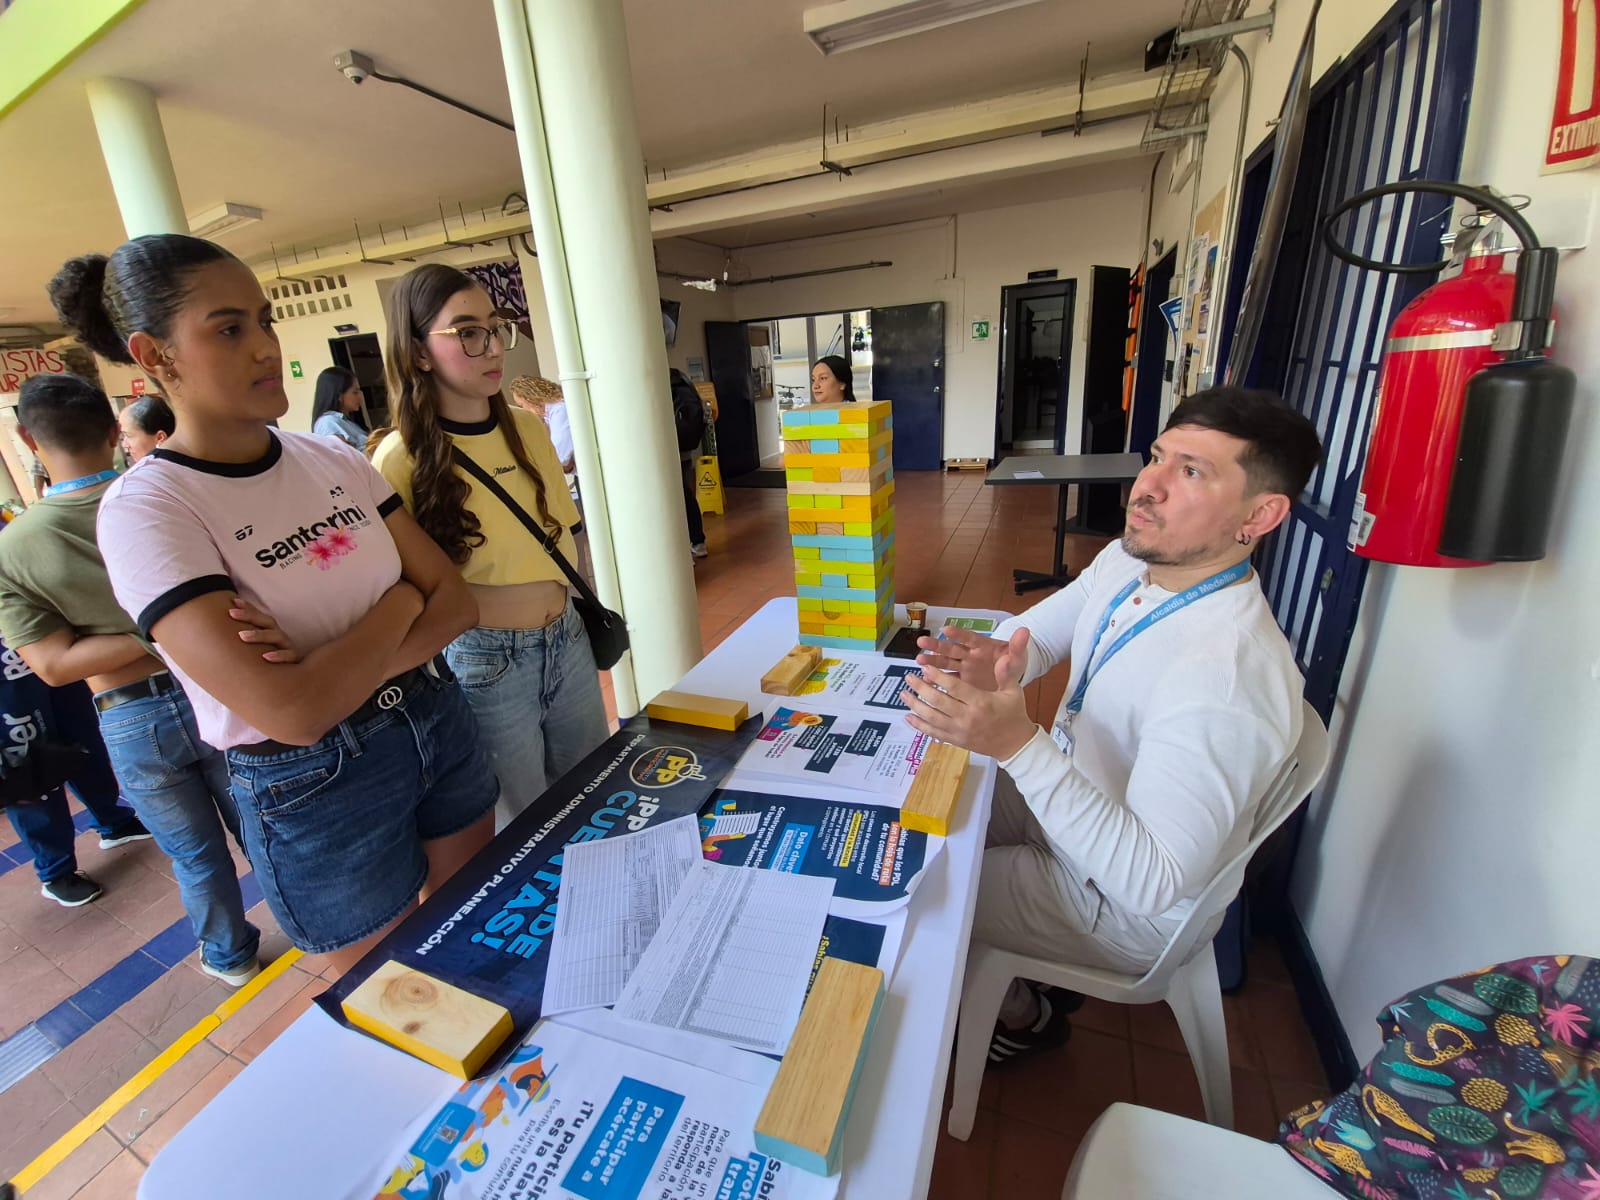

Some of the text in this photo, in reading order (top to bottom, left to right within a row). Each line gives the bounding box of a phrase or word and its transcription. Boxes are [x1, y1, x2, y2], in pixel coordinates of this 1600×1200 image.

[2, 350, 64, 373] ISTAS
[255, 500, 367, 568] santorini
[1186, 590, 1199, 601] de
[584, 734, 646, 793] DEPARTAMENTO
[658, 756, 688, 783] PP
[627, 795, 660, 833] ¡PP
[761, 806, 786, 848] Construyamos
[882, 823, 889, 831] de
[501, 793, 585, 874] ADMINISTRATIVO
[795, 832, 808, 849] Dato
[899, 827, 909, 846] abías
[871, 840, 885, 881] comunidad?
[896, 847, 904, 860] que
[416, 874, 504, 955] PLANEACIÓN
[518, 1119, 536, 1142] para
[581, 1097, 633, 1182] acércate a
[637, 1106, 664, 1142] Para
[680, 1117, 691, 1133] del
[703, 1126, 719, 1156] nacer
[510, 1118, 565, 1199] es la clav
[528, 1101, 594, 1200] ¡Tu particip
[600, 1100, 647, 1186] participar
[674, 1120, 700, 1170] responda
[676, 1122, 710, 1192] participación
[498, 1157, 522, 1191] nueva
[669, 1175, 676, 1183] a
[695, 1160, 705, 1175] de
[697, 1129, 730, 1197] Para que un
[717, 1163, 743, 1200] tran
[739, 1159, 760, 1200] prot
[688, 1180, 699, 1190] la
